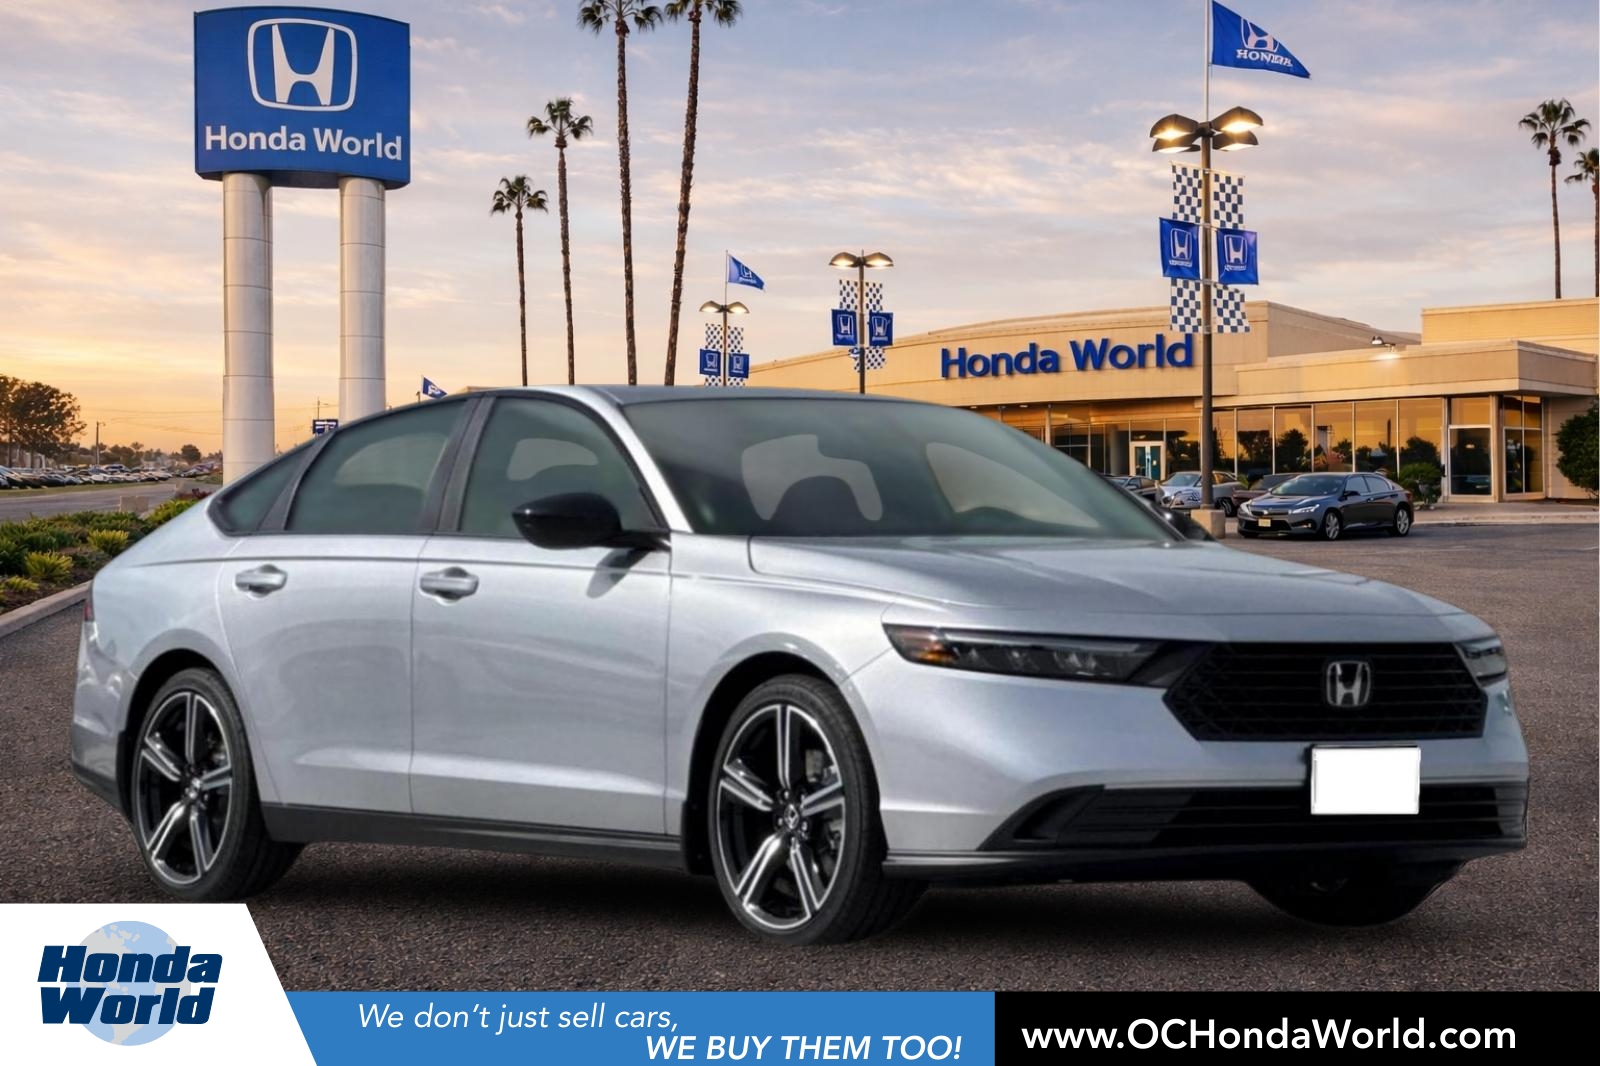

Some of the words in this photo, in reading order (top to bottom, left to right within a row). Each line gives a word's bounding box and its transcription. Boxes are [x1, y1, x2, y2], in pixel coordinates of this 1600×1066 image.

[205, 125, 306, 151] Honda
[313, 127, 402, 161] World
[941, 342, 1060, 377] Honda
[1070, 333, 1194, 370] World
